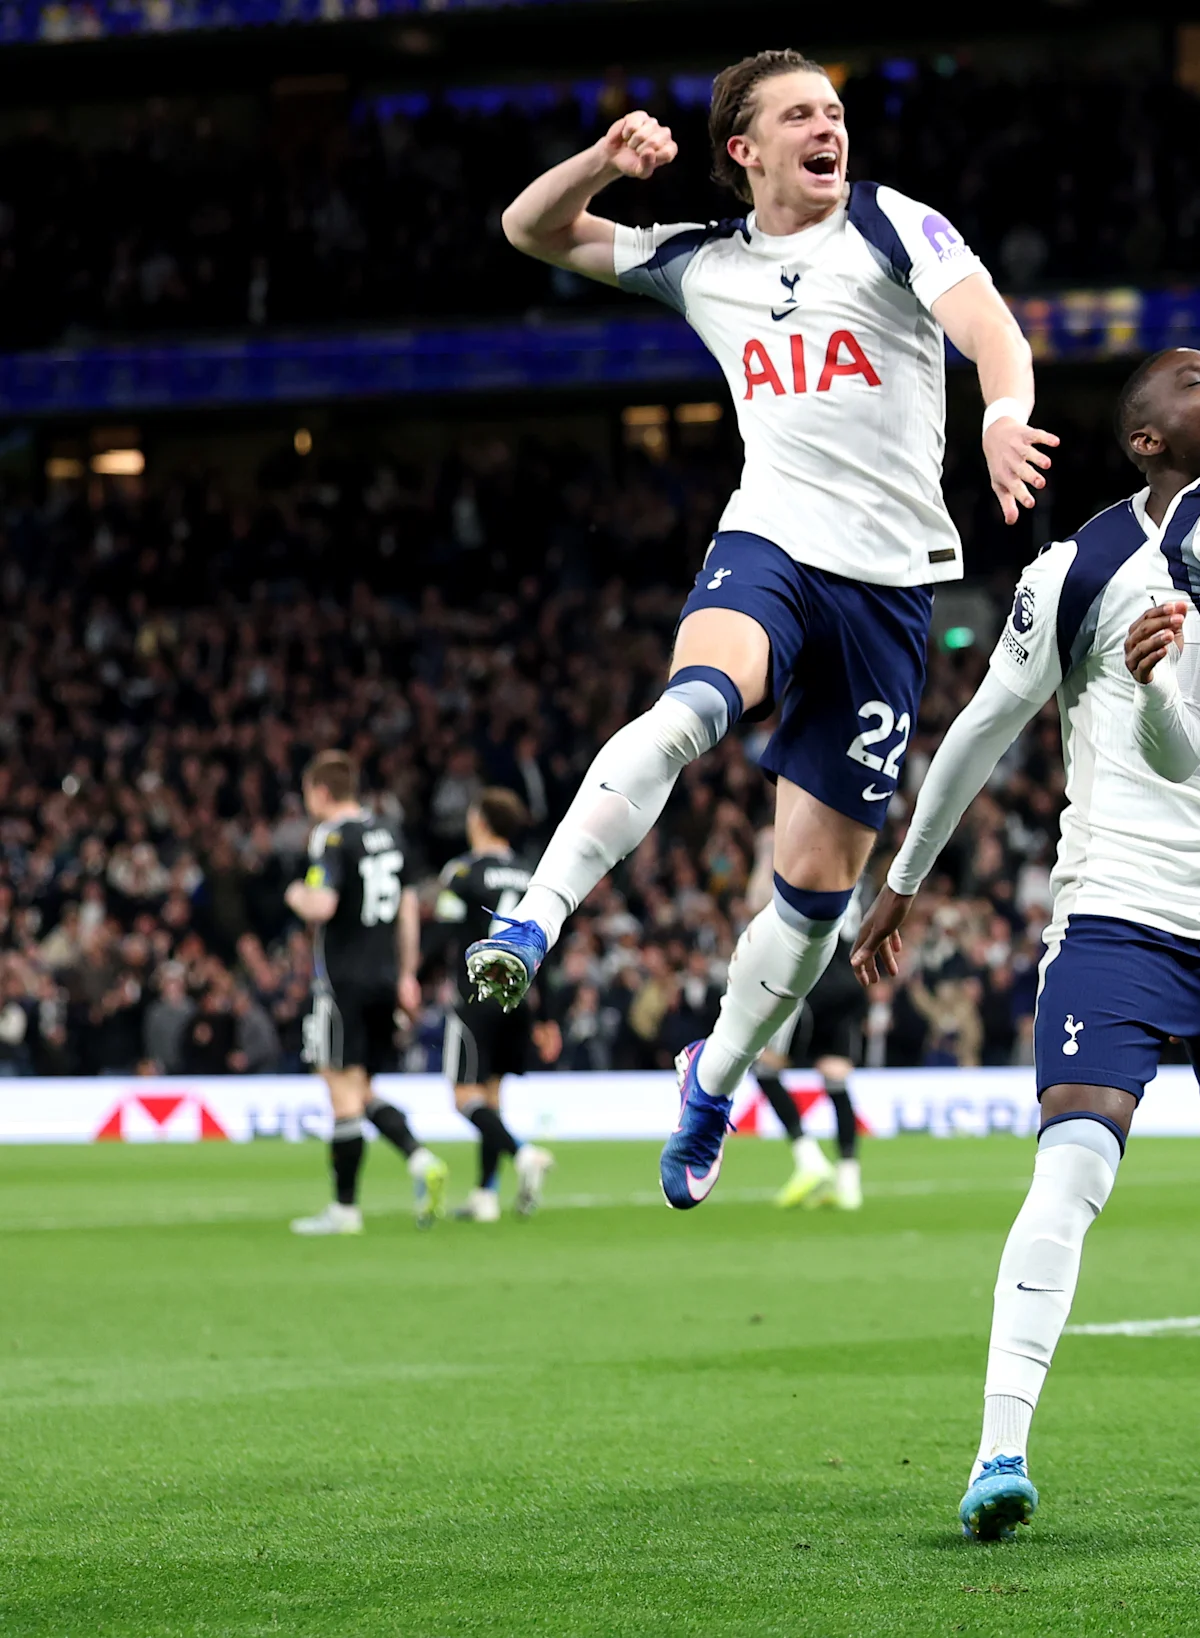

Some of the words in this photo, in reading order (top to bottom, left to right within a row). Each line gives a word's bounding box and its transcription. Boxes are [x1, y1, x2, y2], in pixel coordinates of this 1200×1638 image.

[743, 330, 882, 400] AIA
[846, 700, 911, 780] 22
[358, 850, 404, 927] 15
